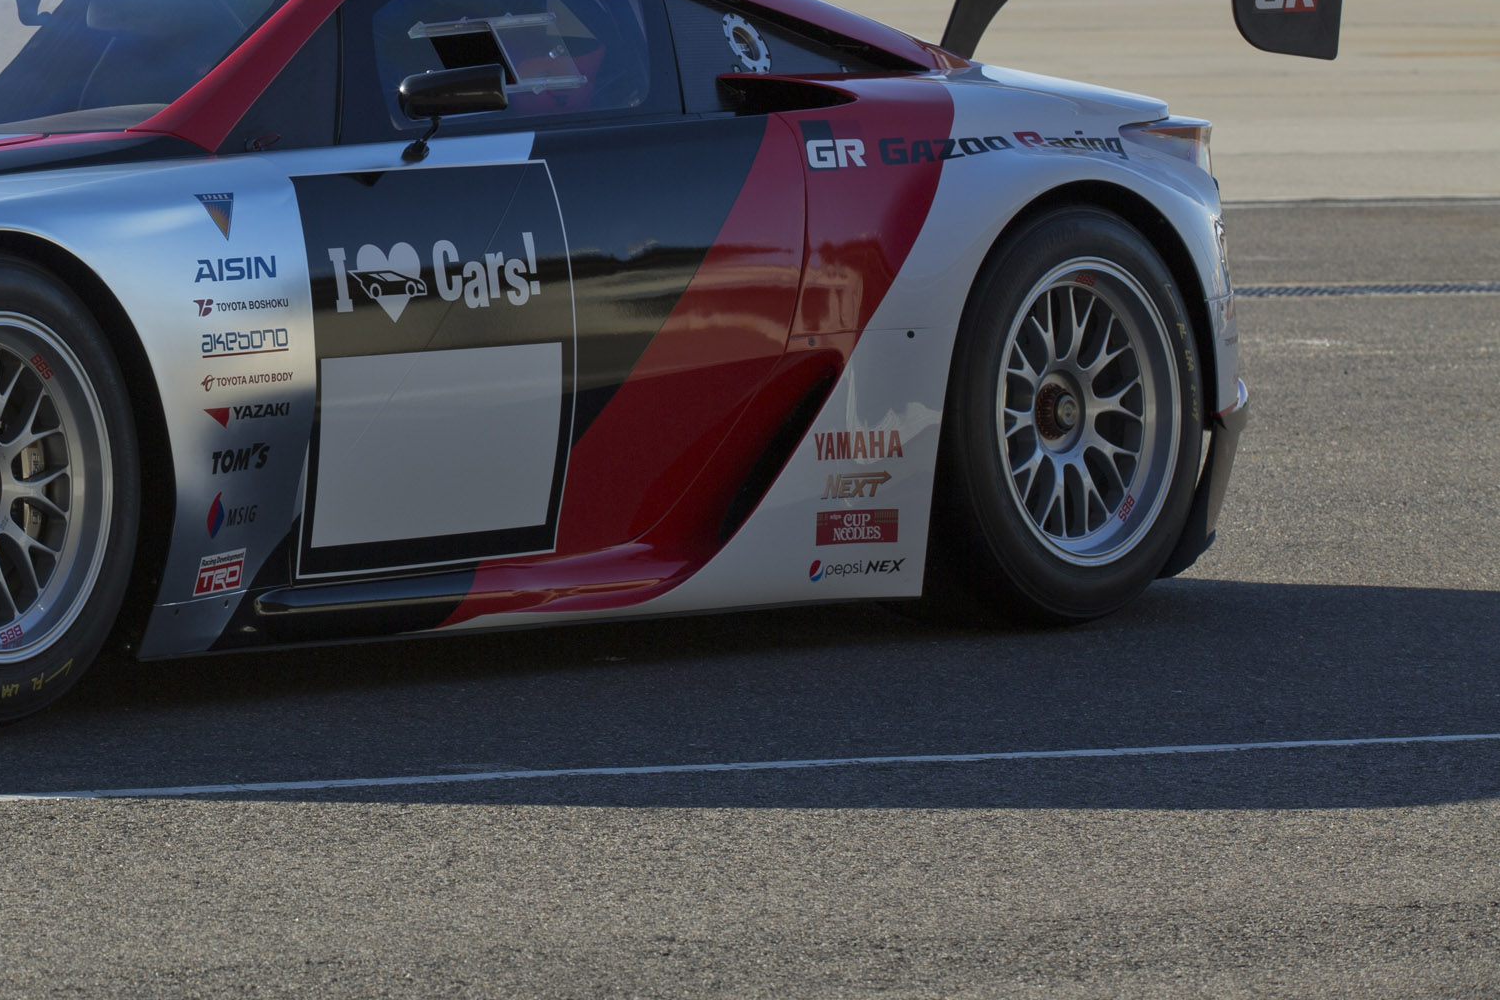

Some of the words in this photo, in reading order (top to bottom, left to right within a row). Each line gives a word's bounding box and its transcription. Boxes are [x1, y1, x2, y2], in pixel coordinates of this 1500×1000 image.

[805, 137, 868, 169] GR
[877, 135, 1015, 166] GAZOO
[1013, 130, 1131, 161] Racing
[194, 255, 277, 284] AISIN
[327, 247, 354, 313] I
[432, 231, 541, 309] Cars!
[216, 300, 247, 312] TOYOTA
[249, 298, 289, 310] BOSHOKU
[30, 353, 55, 380] BBS
[216, 375, 248, 387] TOYOTA
[248, 373, 271, 385] AUTO
[271, 371, 294, 383] BODY
[233, 402, 290, 420] YAZAKI
[211, 442, 271, 475] TOM'S
[814, 429, 904, 461] YAMAHA
[820, 472, 887, 500] NEXT
[226, 504, 258, 527] MSIG
[843, 513, 871, 527] CUP
[1117, 494, 1136, 523] BBS
[833, 526, 882, 541] NOODLES
[200, 565, 241, 592] TRD
[825, 559, 863, 579] pepsi
[864, 557, 907, 575] NEX
[0, 624, 24, 644] BBS
